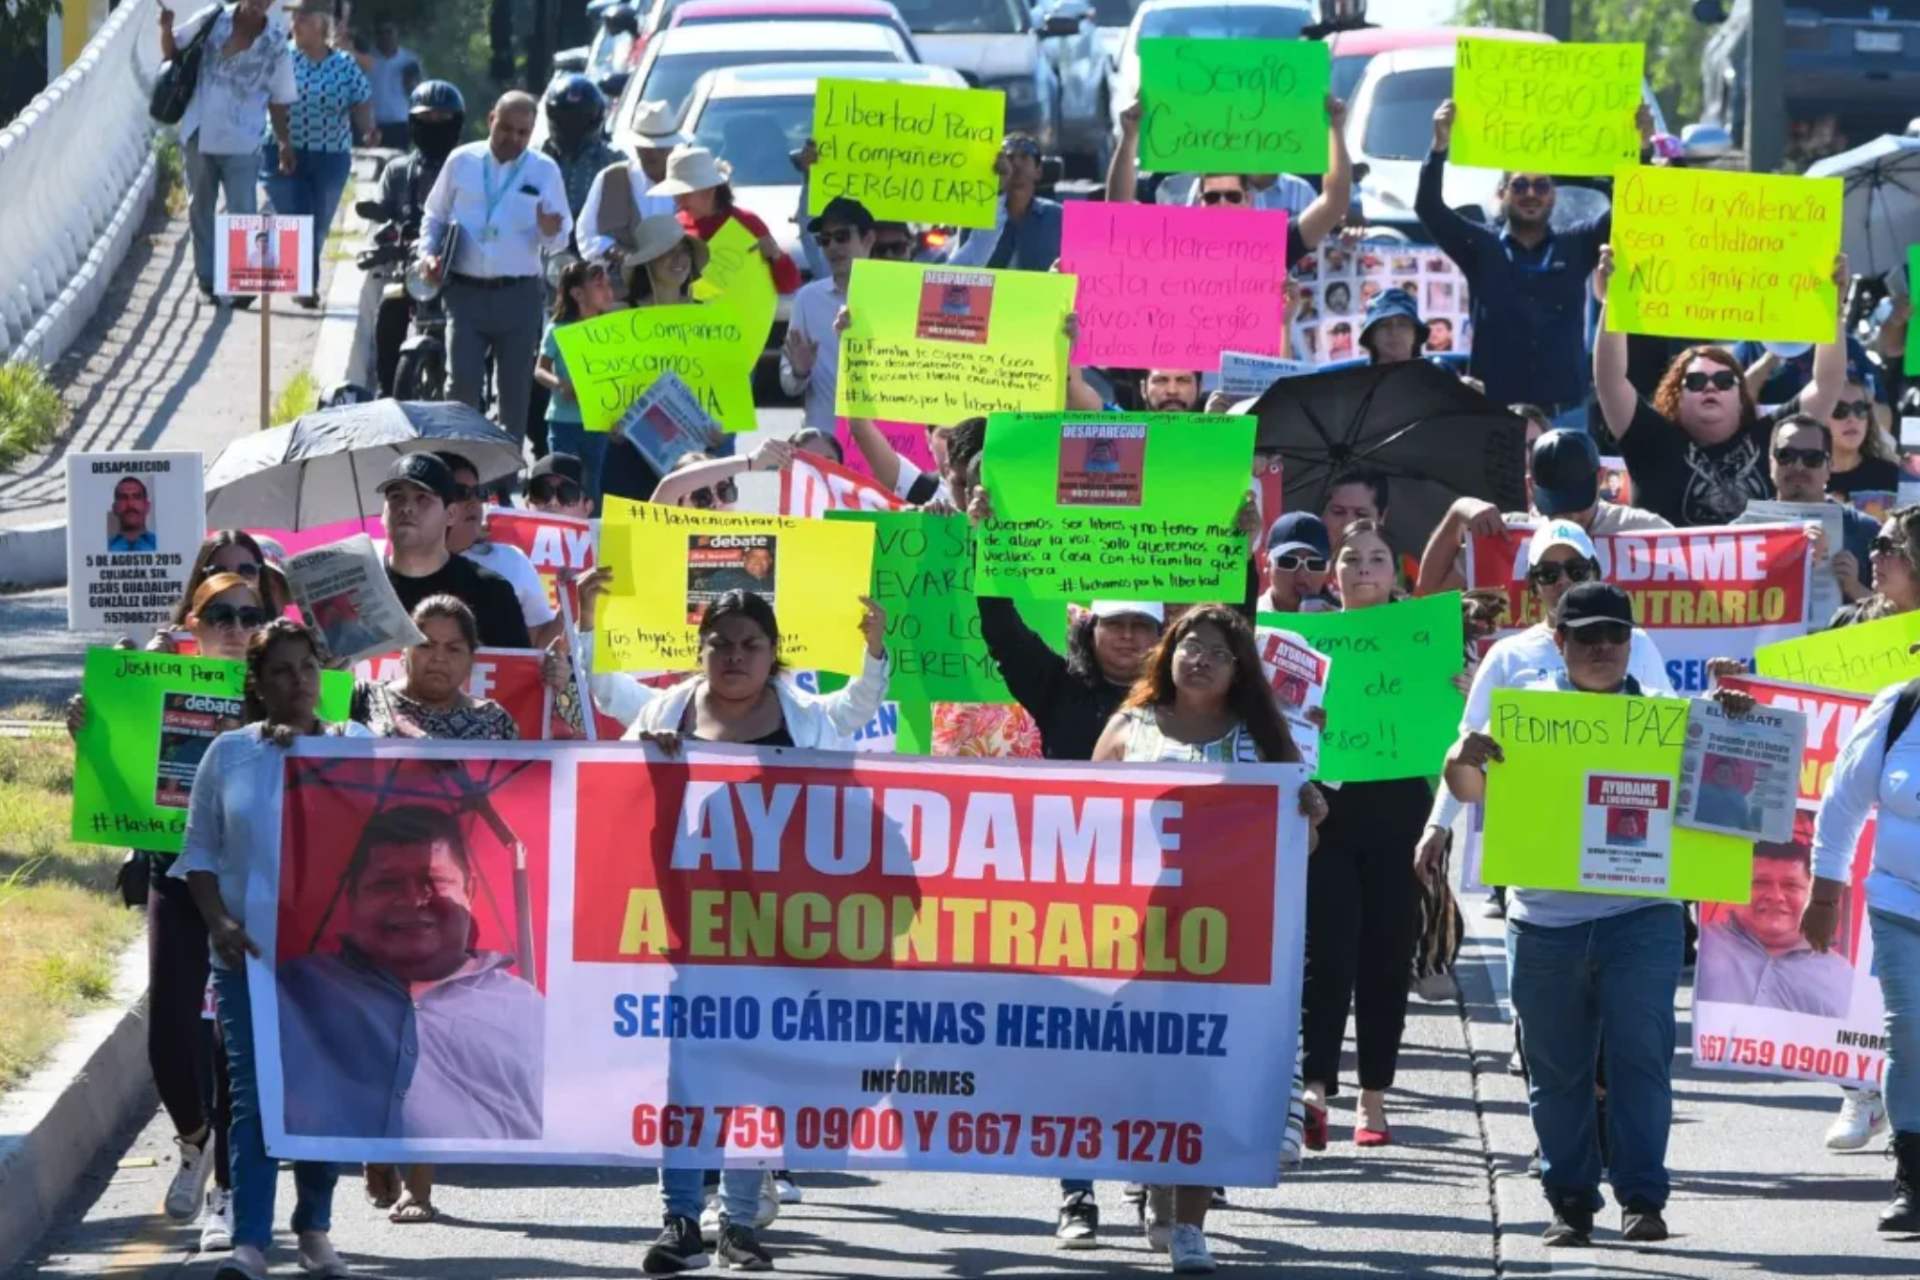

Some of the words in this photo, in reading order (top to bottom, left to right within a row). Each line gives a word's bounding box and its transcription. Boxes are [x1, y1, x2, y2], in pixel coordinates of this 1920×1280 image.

[1175, 43, 1297, 121] Sergio
[824, 88, 936, 135] Libertad
[822, 171, 925, 203] SERGIO
[1623, 173, 1679, 216] Que
[1690, 183, 1715, 216] la
[1722, 185, 1827, 224] violencia
[1108, 214, 1276, 265] Lucharemos
[1624, 228, 1665, 250] sea
[1628, 254, 1676, 297] NO
[1687, 264, 1781, 303] significa
[1787, 272, 1823, 301] que
[1188, 302, 1260, 342] Sergio
[1062, 424, 1146, 439] DESAPARECIDO
[91, 459, 171, 474] DESAPARECIDO
[709, 535, 769, 549] debate
[86, 555, 94, 568] 5
[96, 555, 110, 568] DE
[111, 554, 152, 567] AGOSTO
[154, 553, 183, 567] 2015
[88, 595, 141, 608] GONZÁLEZ
[122, 580, 183, 594] GUADALUPE
[115, 654, 182, 679] Justicia
[1364, 671, 1402, 698] de
[184, 694, 242, 715] debate
[1705, 705, 1722, 718] EL
[1498, 702, 1610, 746] PEDIMOS
[1623, 699, 1685, 748] PAZ
[1601, 780, 1659, 797] AYUDAME
[671, 779, 1184, 887] AYUDAME
[618, 888, 670, 955] A
[689, 889, 1229, 977] ENCONTRARLO
[613, 992, 761, 1042] SERGIO
[771, 988, 986, 1046] CÁRDENAS
[994, 1001, 1230, 1058] HERNÁNDEZ
[1730, 1037, 1777, 1068] 759
[1780, 1042, 1850, 1079] 0900
[1855, 1053, 1871, 1082] Y
[861, 1068, 976, 1097] INFORMES
[632, 1102, 706, 1148] 667
[713, 1104, 786, 1150] 759
[794, 1106, 904, 1152] 0900
[914, 1110, 938, 1152] Y
[946, 1111, 1022, 1156] 667
[1030, 1114, 1103, 1160] 573
[1111, 1118, 1203, 1166] 1276
